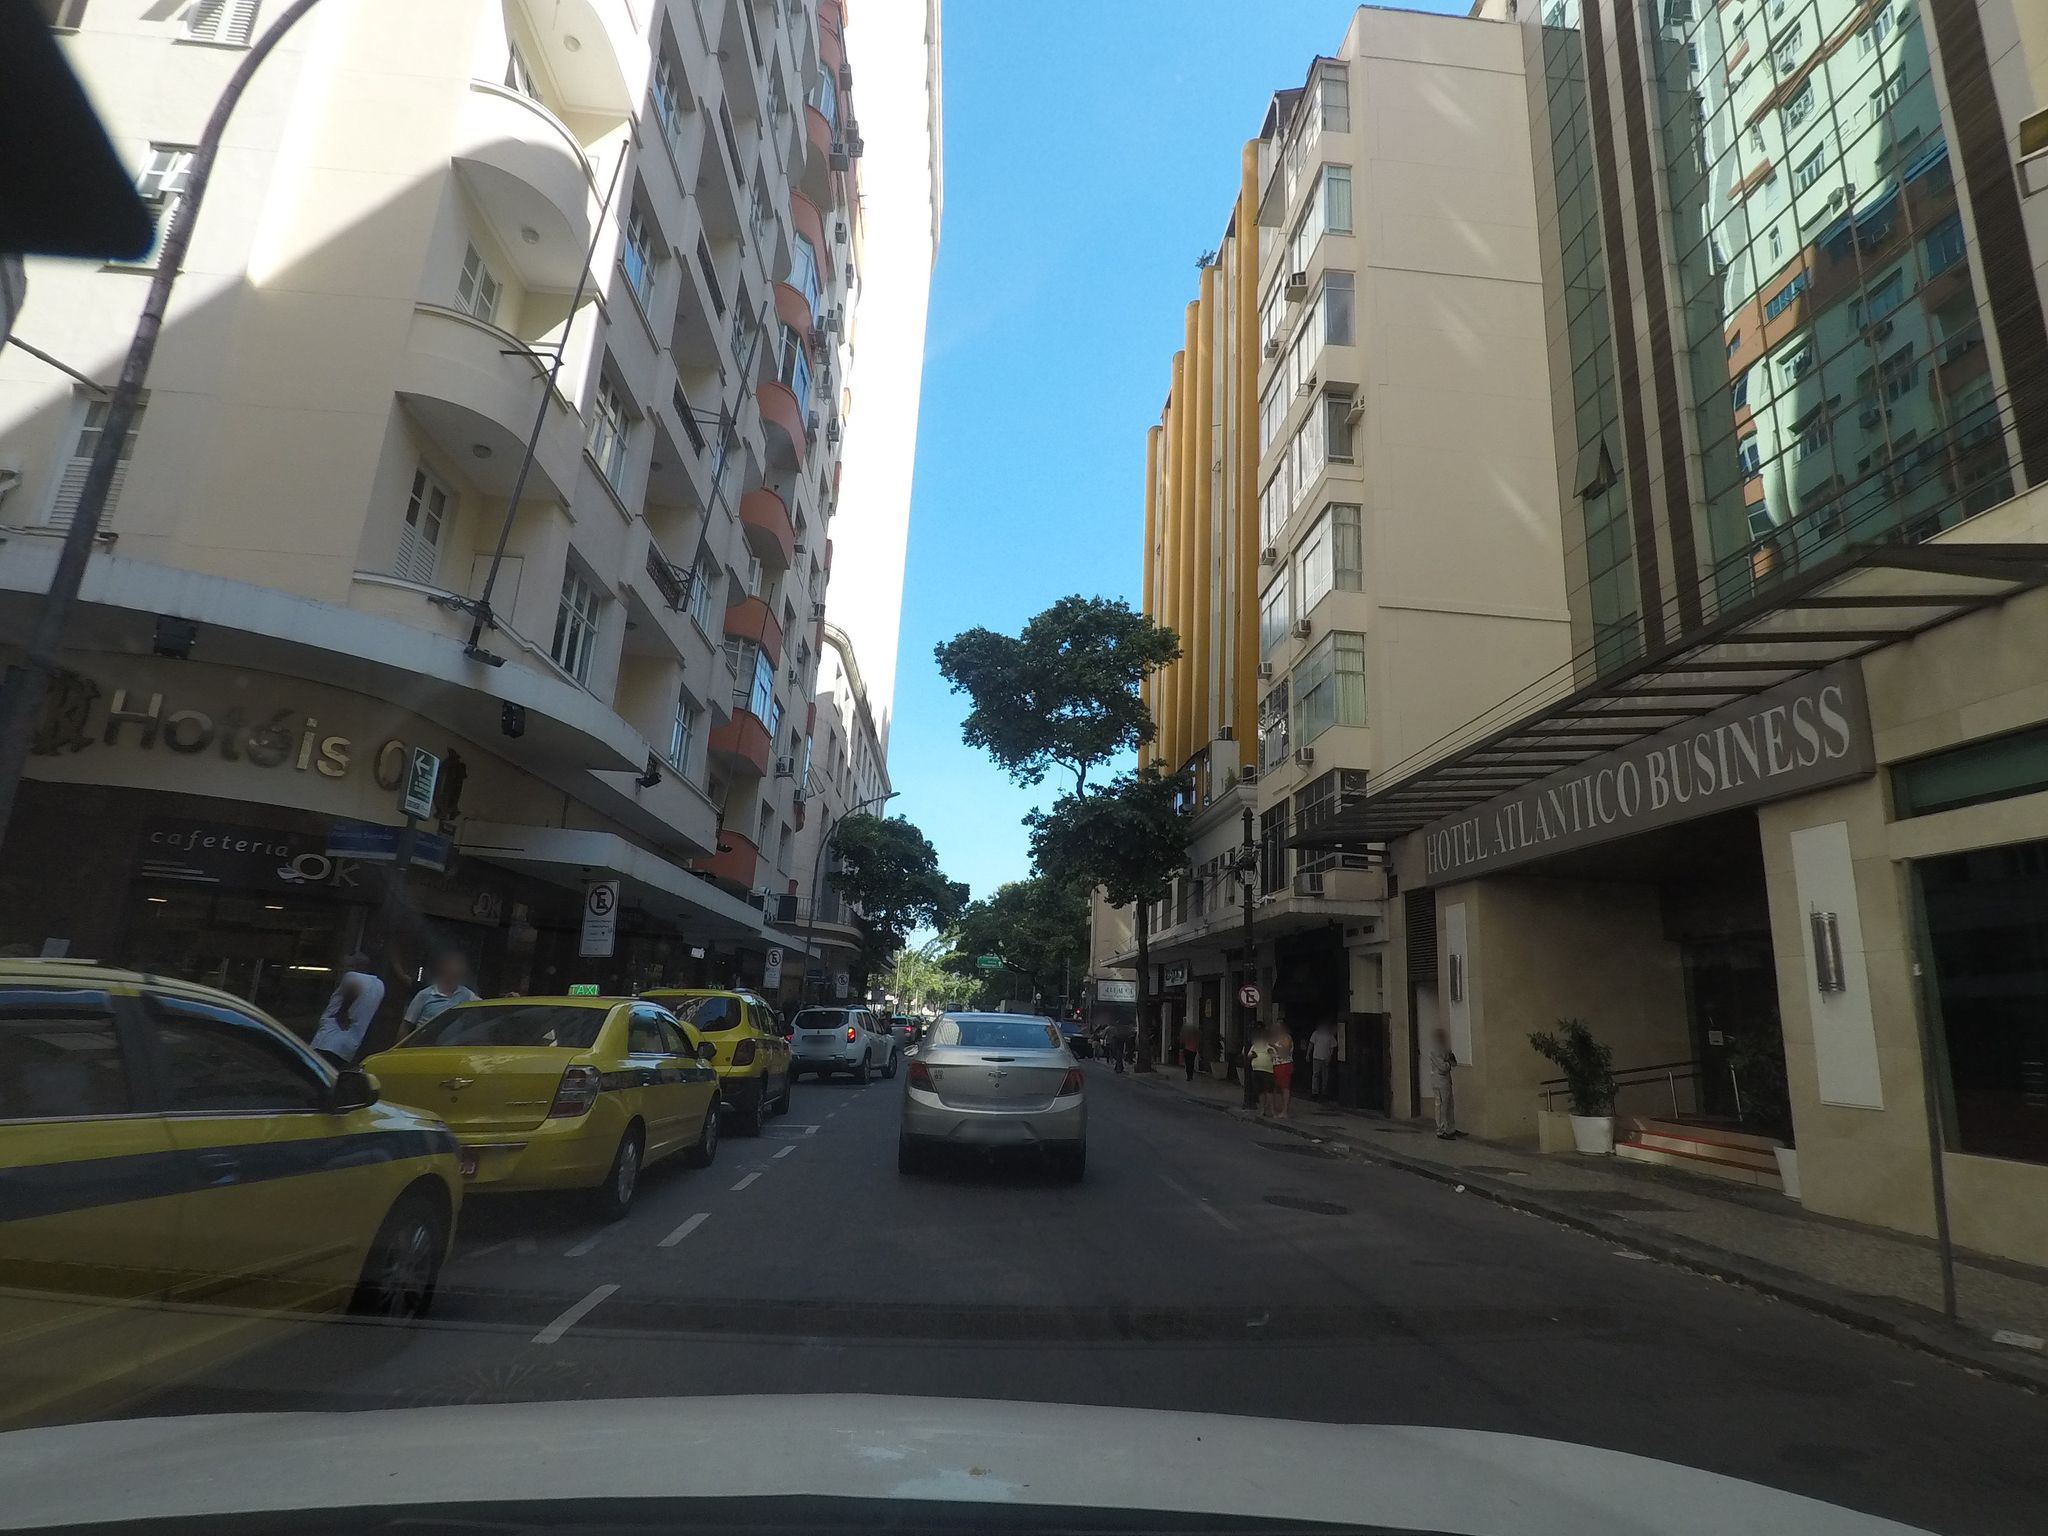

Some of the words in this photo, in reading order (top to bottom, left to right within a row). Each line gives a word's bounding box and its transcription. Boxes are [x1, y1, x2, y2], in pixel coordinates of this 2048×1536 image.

[103, 688, 351, 778] Hotéis
[1427, 817, 1488, 874] HOTEL
[1493, 760, 1641, 855] ATLANTICO
[1646, 685, 1850, 810] BUSINESS
[151, 830, 289, 857] cafeteria
[292, 853, 361, 888] OK
[570, 984, 599, 996] TAXI
